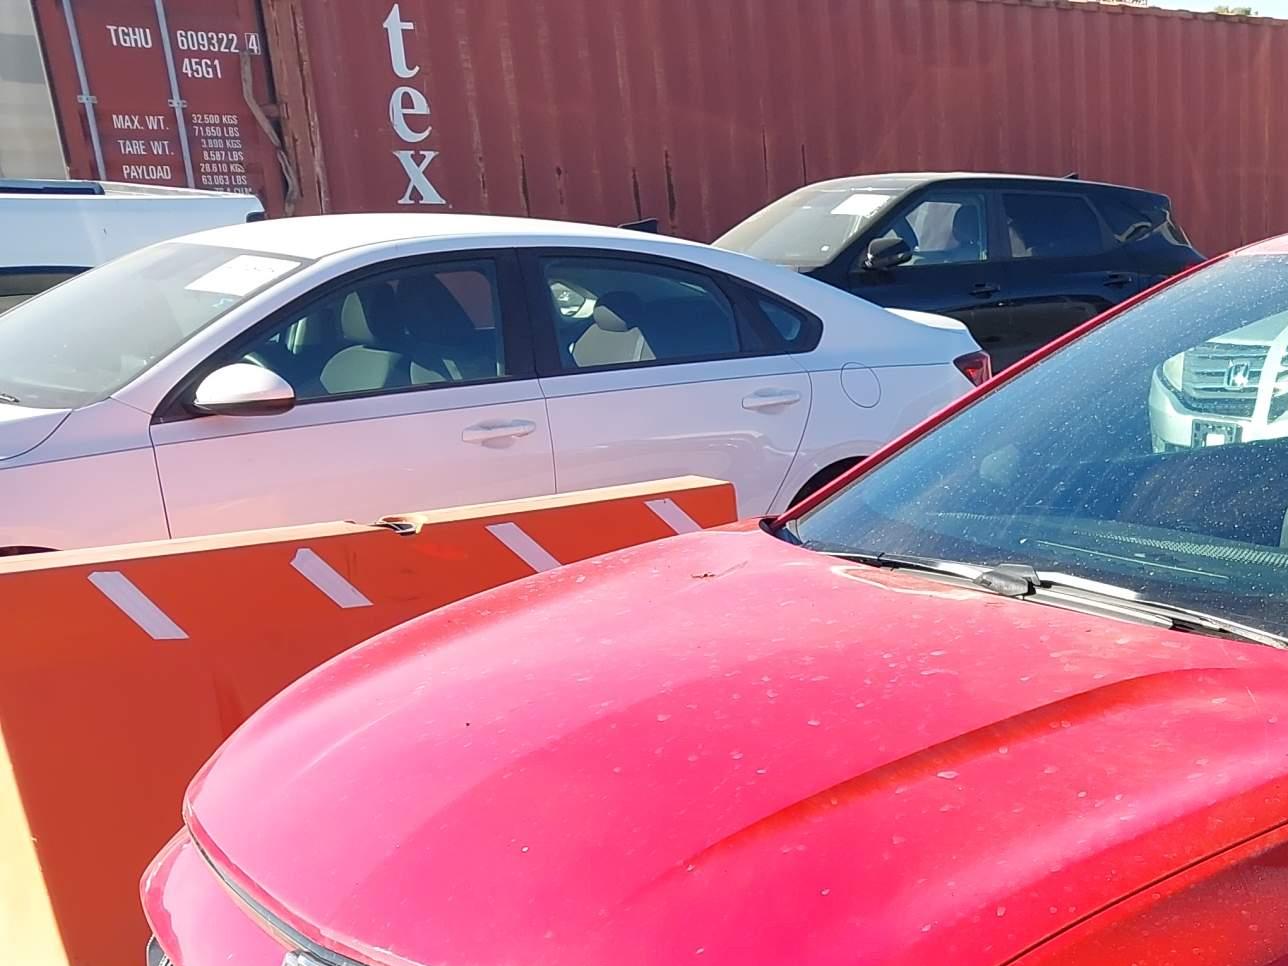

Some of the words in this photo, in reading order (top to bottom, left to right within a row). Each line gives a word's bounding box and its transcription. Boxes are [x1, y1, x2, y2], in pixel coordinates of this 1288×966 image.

[105, 25, 153, 49] TGHU
[176, 30, 240, 53] 609322
[247, 33, 259, 54] 4
[182, 58, 222, 79] 45G1
[383, 3, 447, 204] tex
[112, 114, 144, 130] MAX.
[145, 115, 170, 131] WT.
[222, 114, 239, 125] KGS
[223, 126, 240, 137] LBS
[117, 139, 147, 155] TARE
[150, 140, 175, 156] WT.
[225, 138, 242, 149] KGS
[227, 151, 245, 161] LBS
[122, 165, 173, 180] PAYLOAD
[229, 163, 246, 173] KGS
[231, 175, 248, 186] LBS
